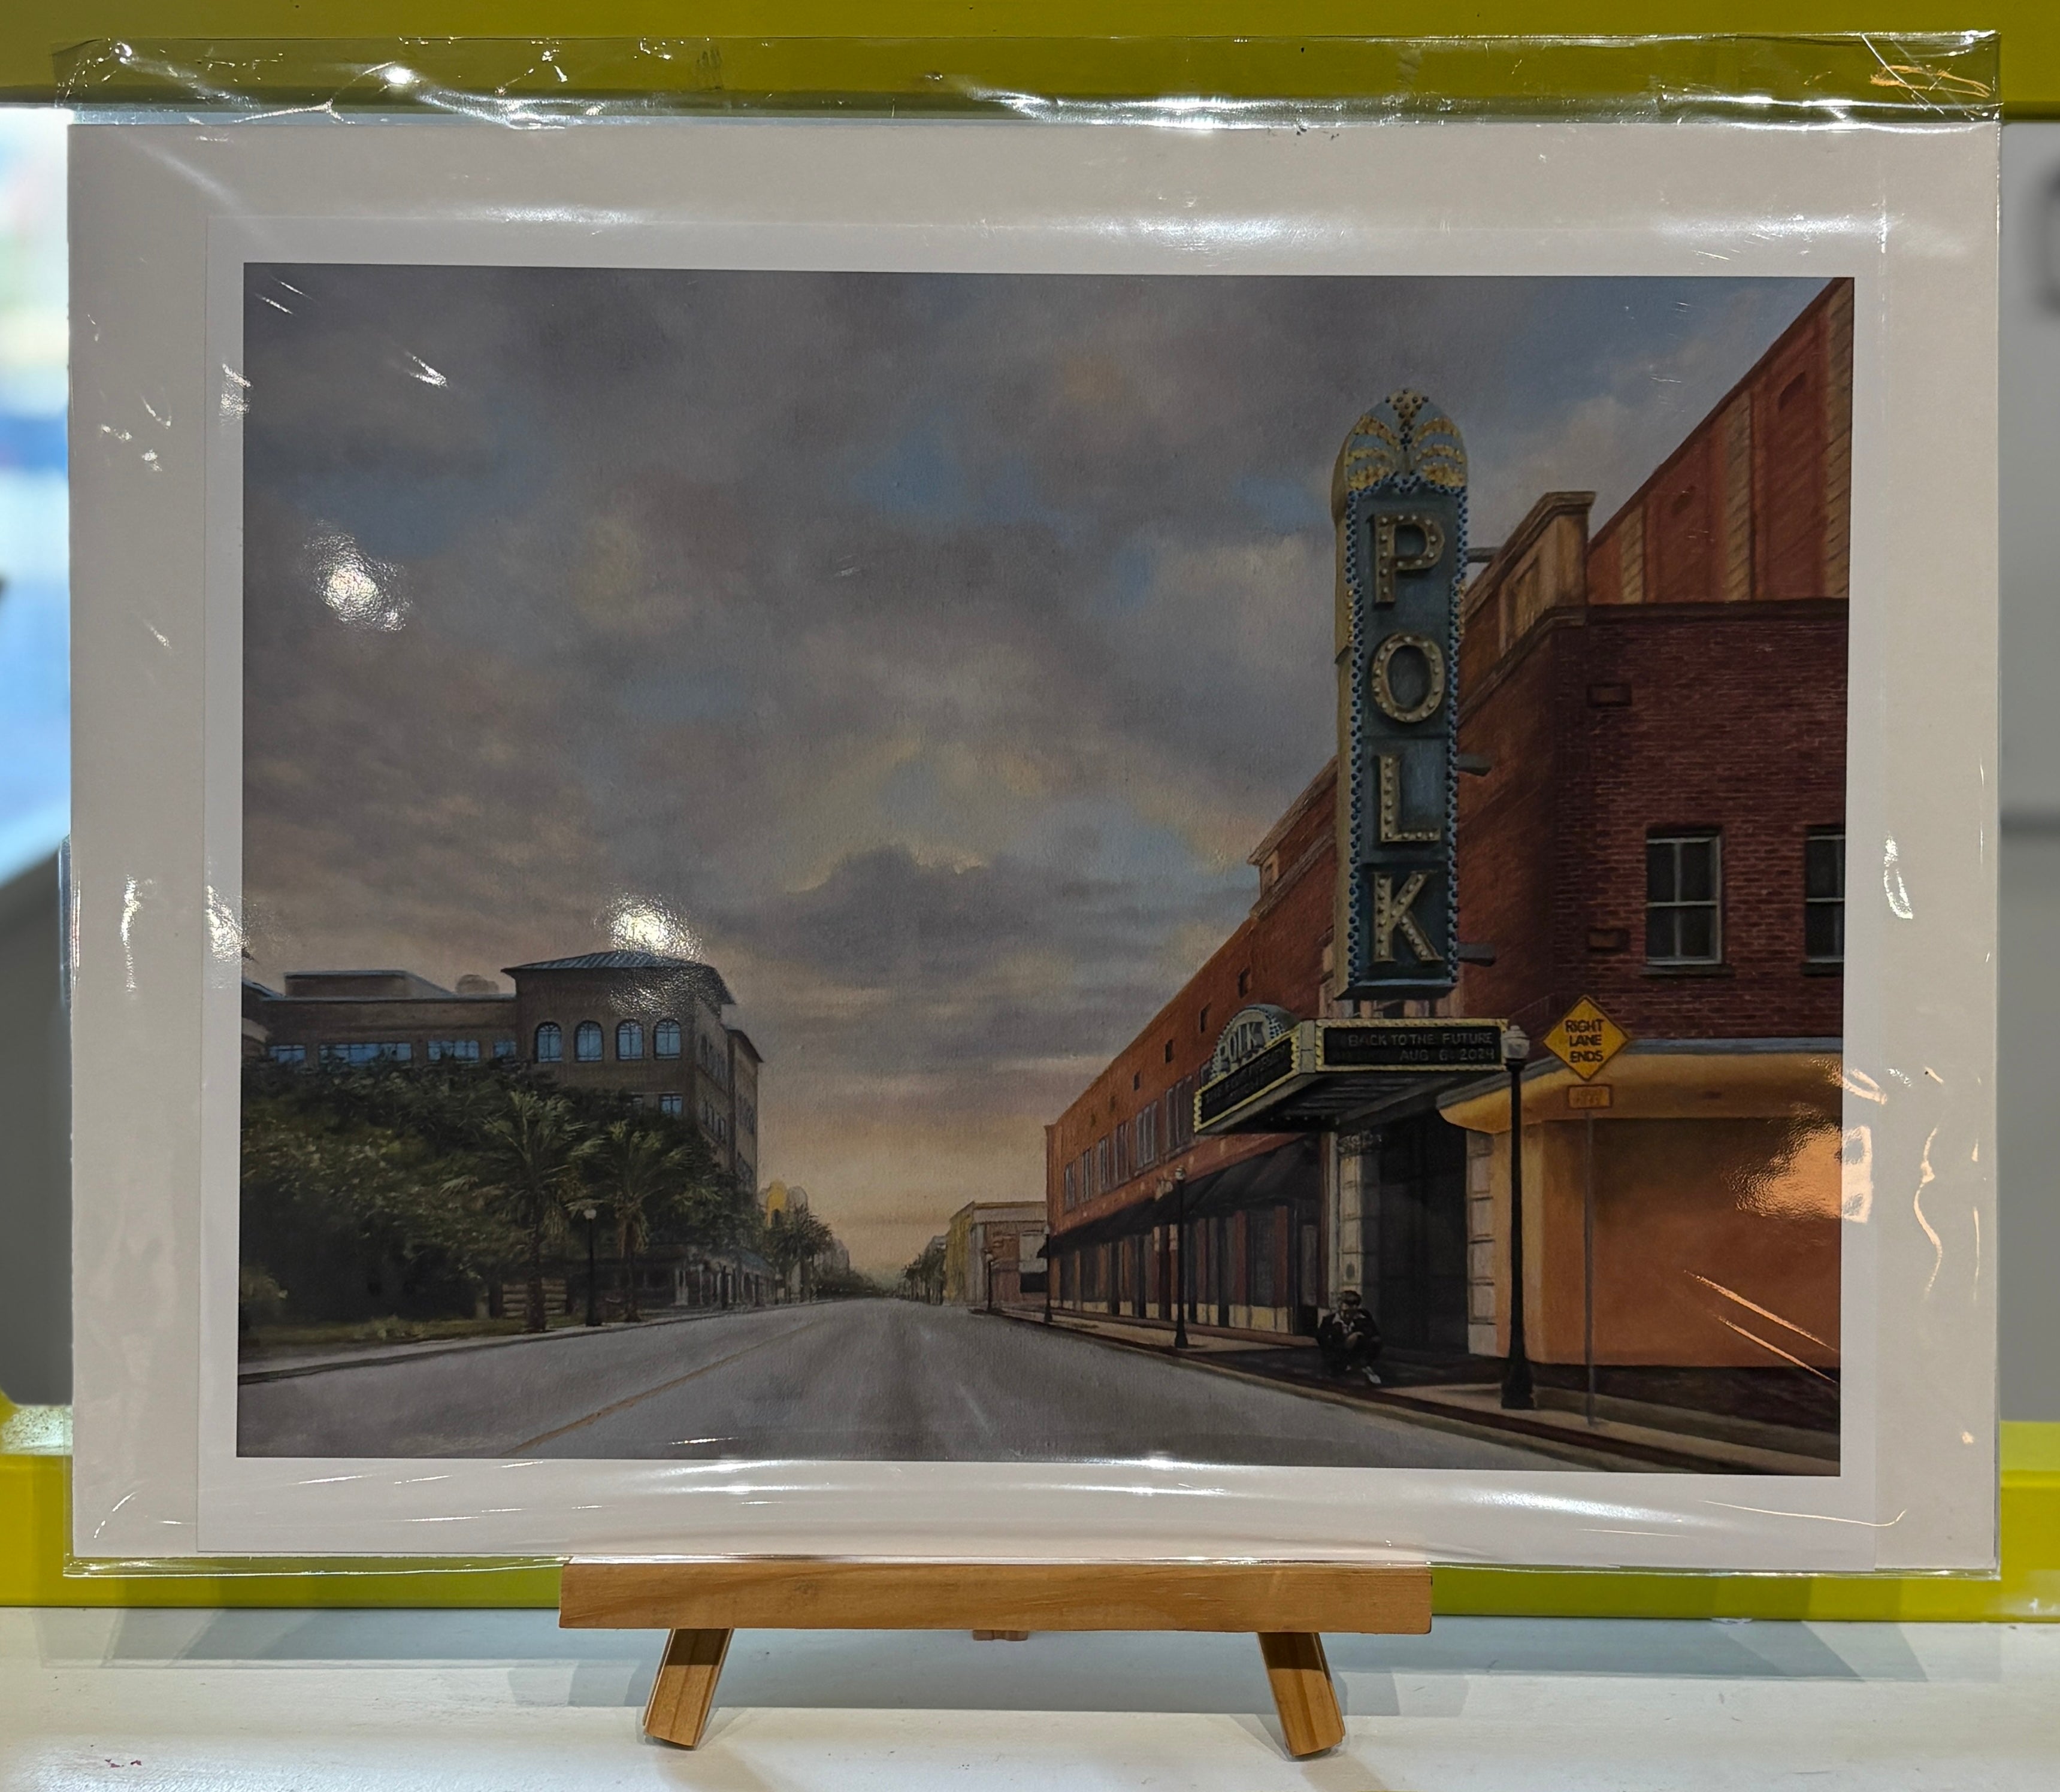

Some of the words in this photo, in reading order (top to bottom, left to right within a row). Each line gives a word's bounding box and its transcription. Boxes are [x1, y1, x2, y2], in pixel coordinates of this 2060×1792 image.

[1372, 513, 1445, 963] POLK
[1565, 1019, 1604, 1033] RIGHT
[1348, 1034, 1387, 1047] BACK
[1391, 1034, 1406, 1046] TO
[1409, 1033, 1436, 1045] THE
[1442, 1032, 1493, 1045] FUTURE
[1569, 1035, 1602, 1047] LANE
[1399, 1049, 1429, 1061] AUG
[1459, 1048, 1495, 1061] 2024
[1569, 1051, 1604, 1063] ENDS
